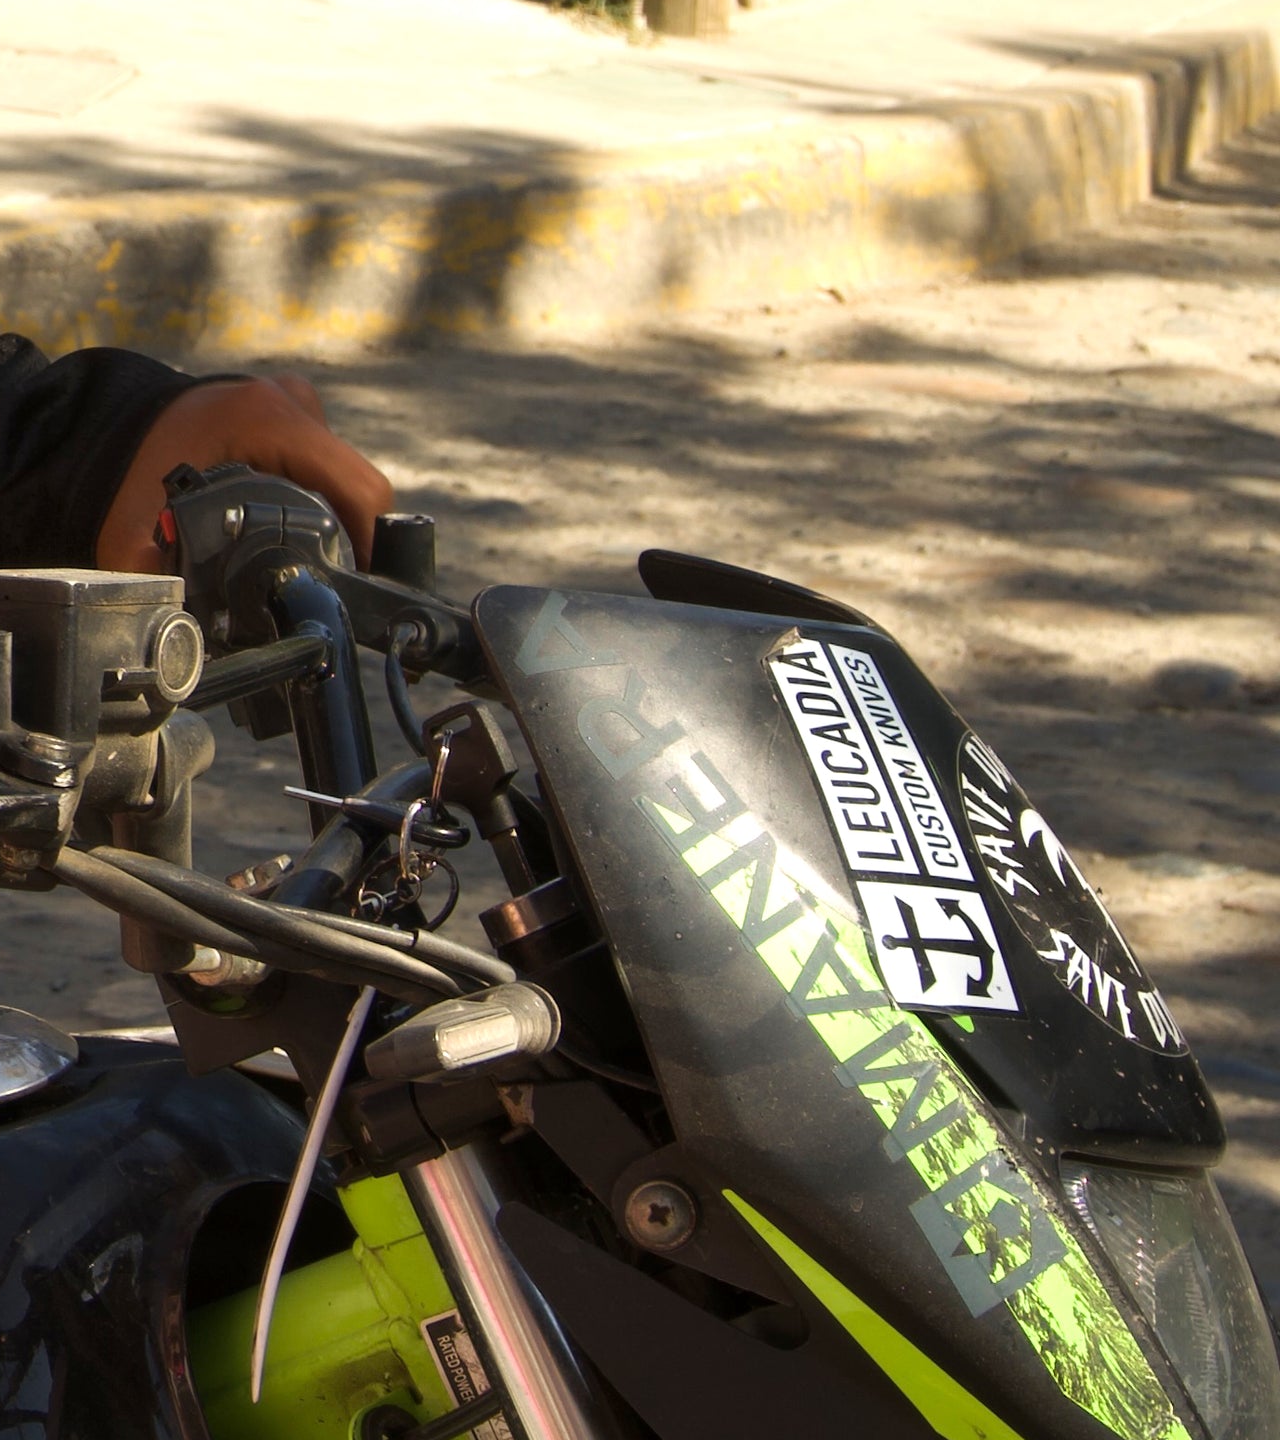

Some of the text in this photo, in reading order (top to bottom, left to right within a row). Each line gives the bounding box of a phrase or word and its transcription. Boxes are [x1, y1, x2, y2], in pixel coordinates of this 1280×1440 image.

[781, 650, 906, 862] LEUCADIA
[843, 654, 960, 869] CUSTOM KNIVES
[961, 772, 1041, 897] SAVE
[1037, 928, 1139, 1040] SAVE
[436, 1333, 477, 1406] RATED POWER
